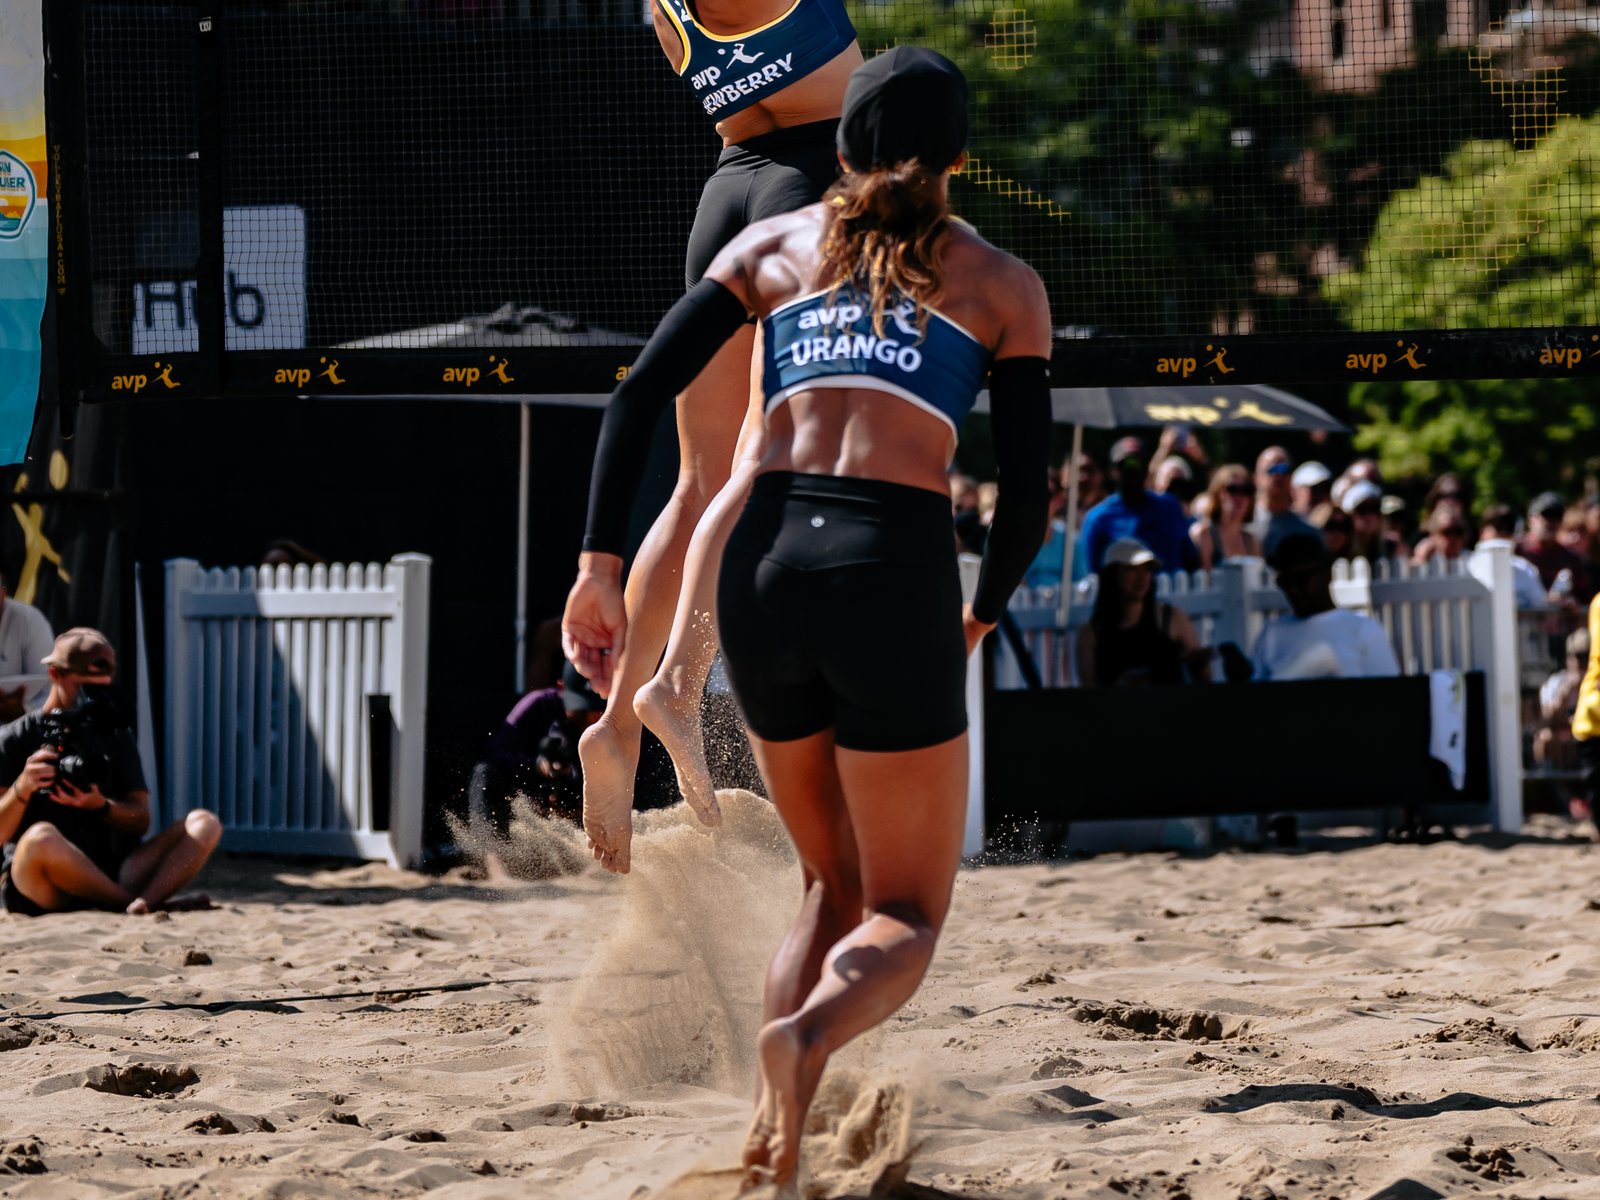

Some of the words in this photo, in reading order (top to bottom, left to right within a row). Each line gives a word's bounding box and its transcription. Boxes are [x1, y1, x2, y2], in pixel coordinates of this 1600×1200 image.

[690, 66, 721, 90] avp
[797, 304, 863, 330] avp
[790, 334, 922, 373] URANGO
[1345, 353, 1388, 374] avp
[1539, 347, 1582, 369] avp
[274, 367, 310, 388] avp
[442, 367, 480, 387] avp
[1156, 357, 1197, 378] avp
[111, 374, 147, 393] avp
